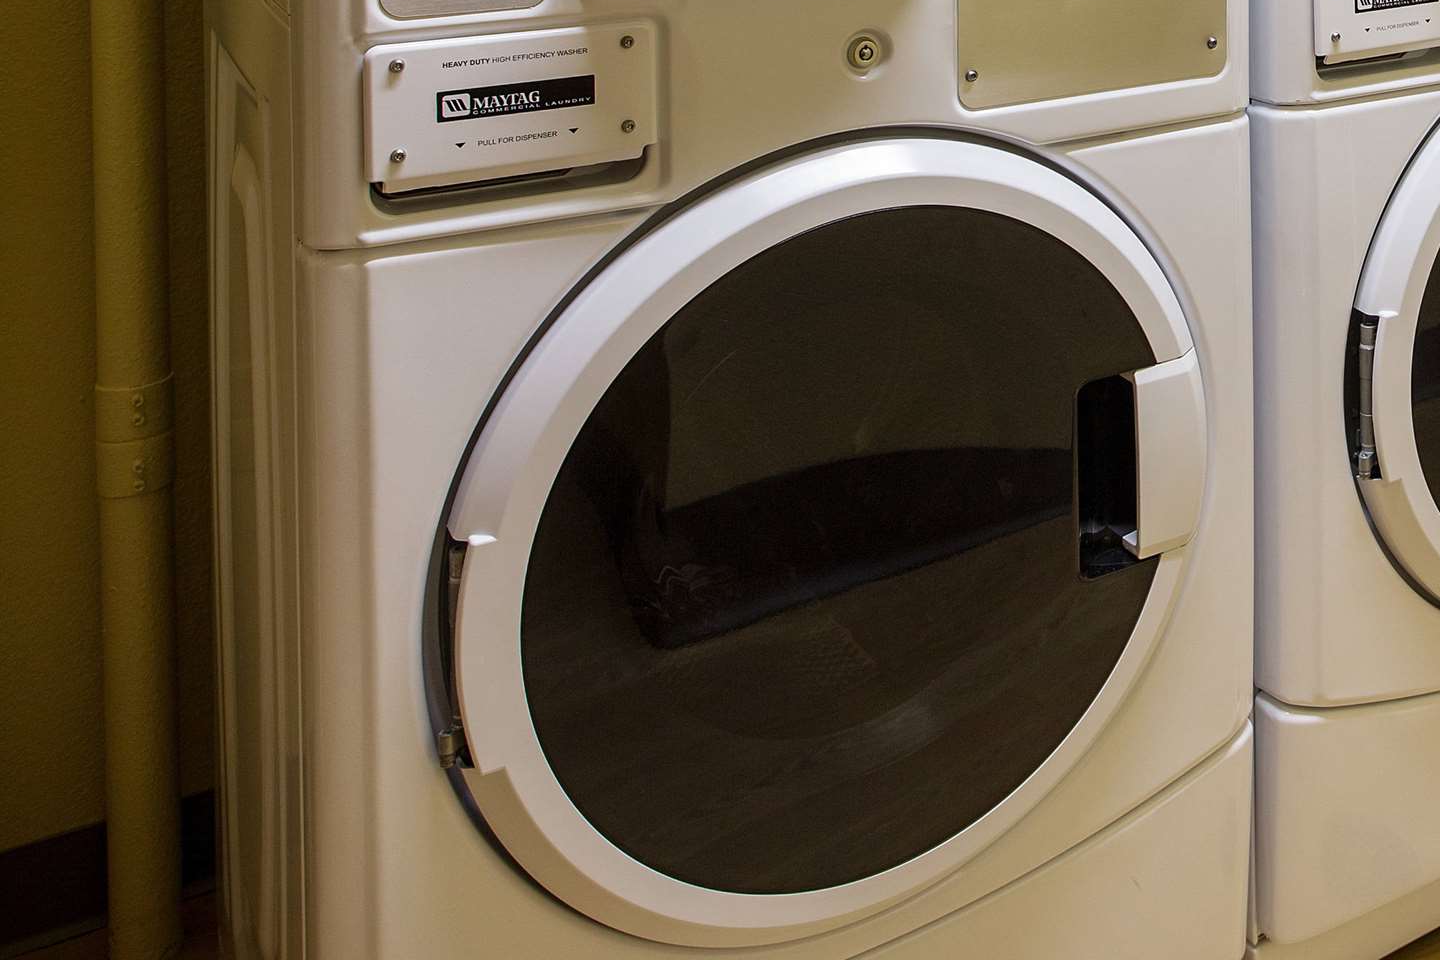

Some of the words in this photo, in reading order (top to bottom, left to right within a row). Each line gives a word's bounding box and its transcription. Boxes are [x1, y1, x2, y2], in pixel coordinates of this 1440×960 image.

[442, 60, 468, 69] HEAVY
[470, 58, 491, 66] DUTY
[492, 56, 511, 64] HIGH
[512, 51, 556, 62] EFFICIENCY
[557, 47, 588, 57] WASHER
[472, 90, 540, 110] MAYTAG
[472, 103, 541, 115] COMMERCIAL
[545, 96, 592, 107] LAUNDRY
[477, 138, 497, 147] PULL
[498, 136, 514, 144] FOR
[515, 130, 558, 142] DISPENSER
